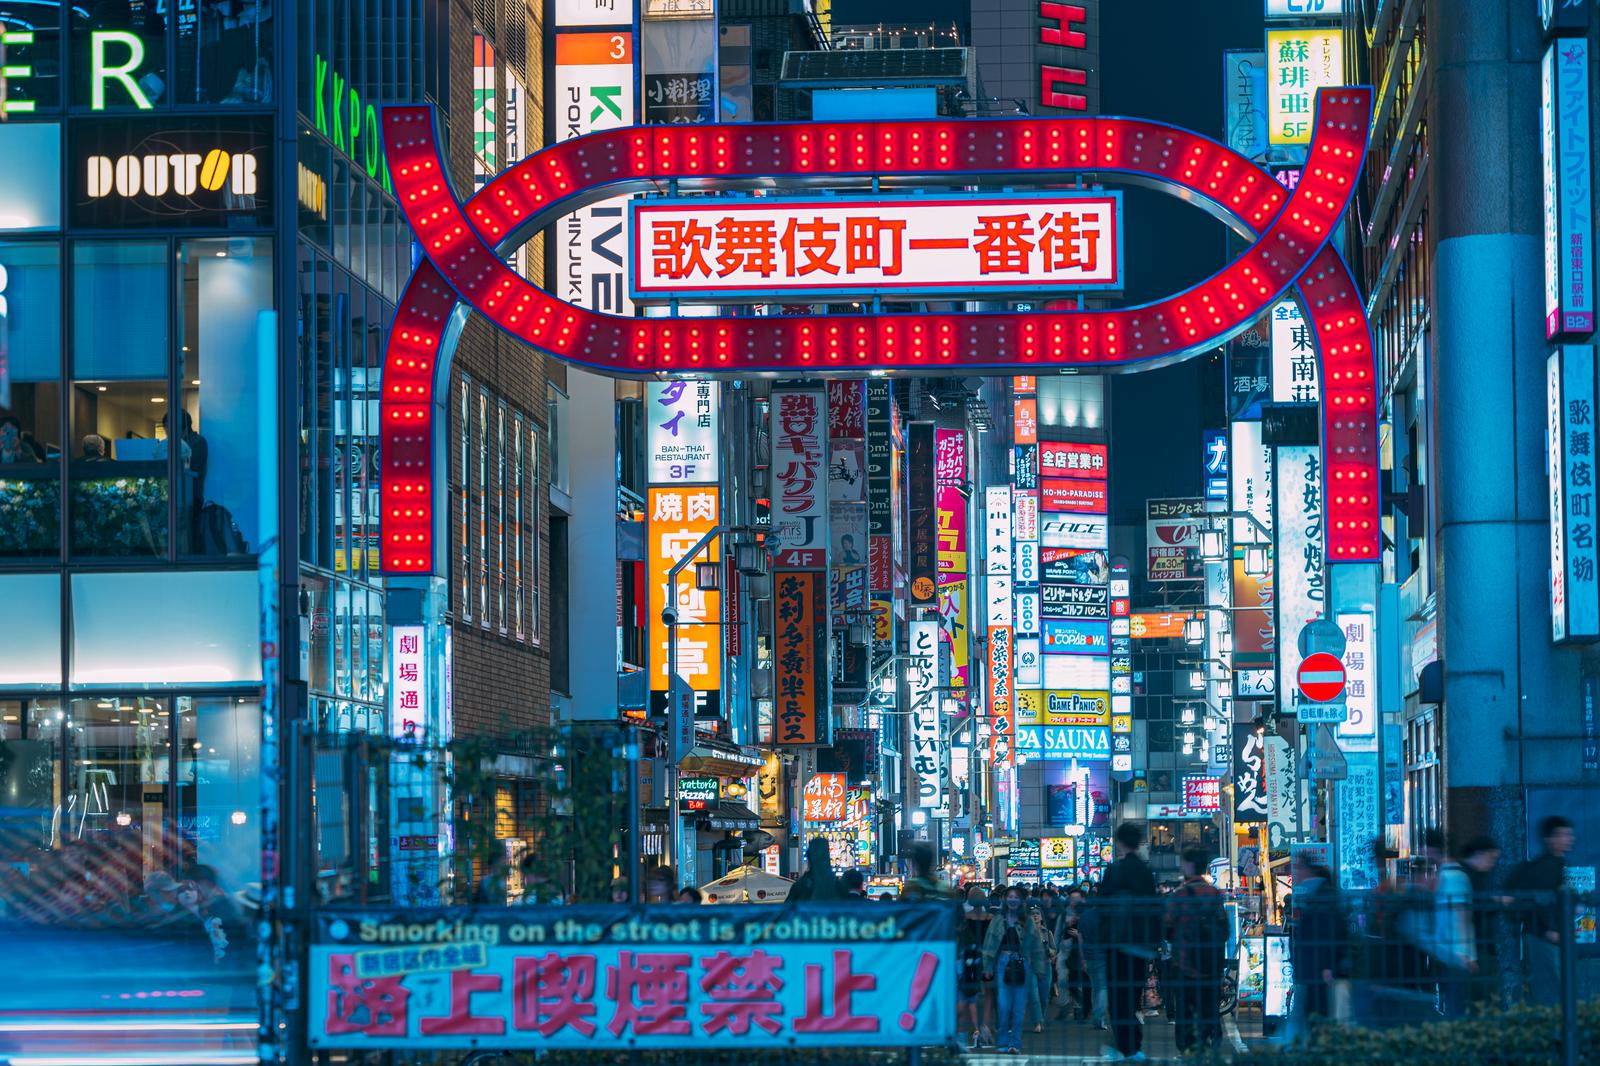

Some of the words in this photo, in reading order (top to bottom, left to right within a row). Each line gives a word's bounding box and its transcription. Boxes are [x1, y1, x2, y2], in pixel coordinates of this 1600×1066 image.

[1279, 41, 1309, 113] 蘇琲亜
[648, 78, 711, 103] 小料理
[1283, 122, 1307, 137] 5F
[87, 149, 257, 197] DOUTOR
[652, 213, 1100, 280] 歌舞伎町一番街
[670, 465, 696, 478] 3F
[1042, 450, 1104, 471] 全店営業中
[1569, 400, 1594, 582] 歌舞伎町名物
[653, 493, 716, 522] 焼肉
[1043, 522, 1104, 534] FACE
[787, 551, 812, 566] 4F
[1022, 544, 1033, 579] GiGO
[1043, 587, 1106, 603] ビリヤード&ダーツ
[1022, 596, 1033, 630] GiGO
[399, 635, 419, 733] 劇場通り
[1345, 623, 1365, 726] 劇場通り
[1049, 694, 1071, 711] GAME
[1073, 695, 1096, 712] PANIC
[1300, 707, 1343, 719] 自転車を除く
[1044, 729, 1109, 749] SAUNA
[688, 801, 704, 809] Bar
[360, 918, 499, 945] Smorking
[509, 922, 545, 942] on
[554, 919, 602, 942] the
[610, 919, 703, 942] street
[711, 918, 736, 941] is
[744, 917, 905, 945] prohibited.
